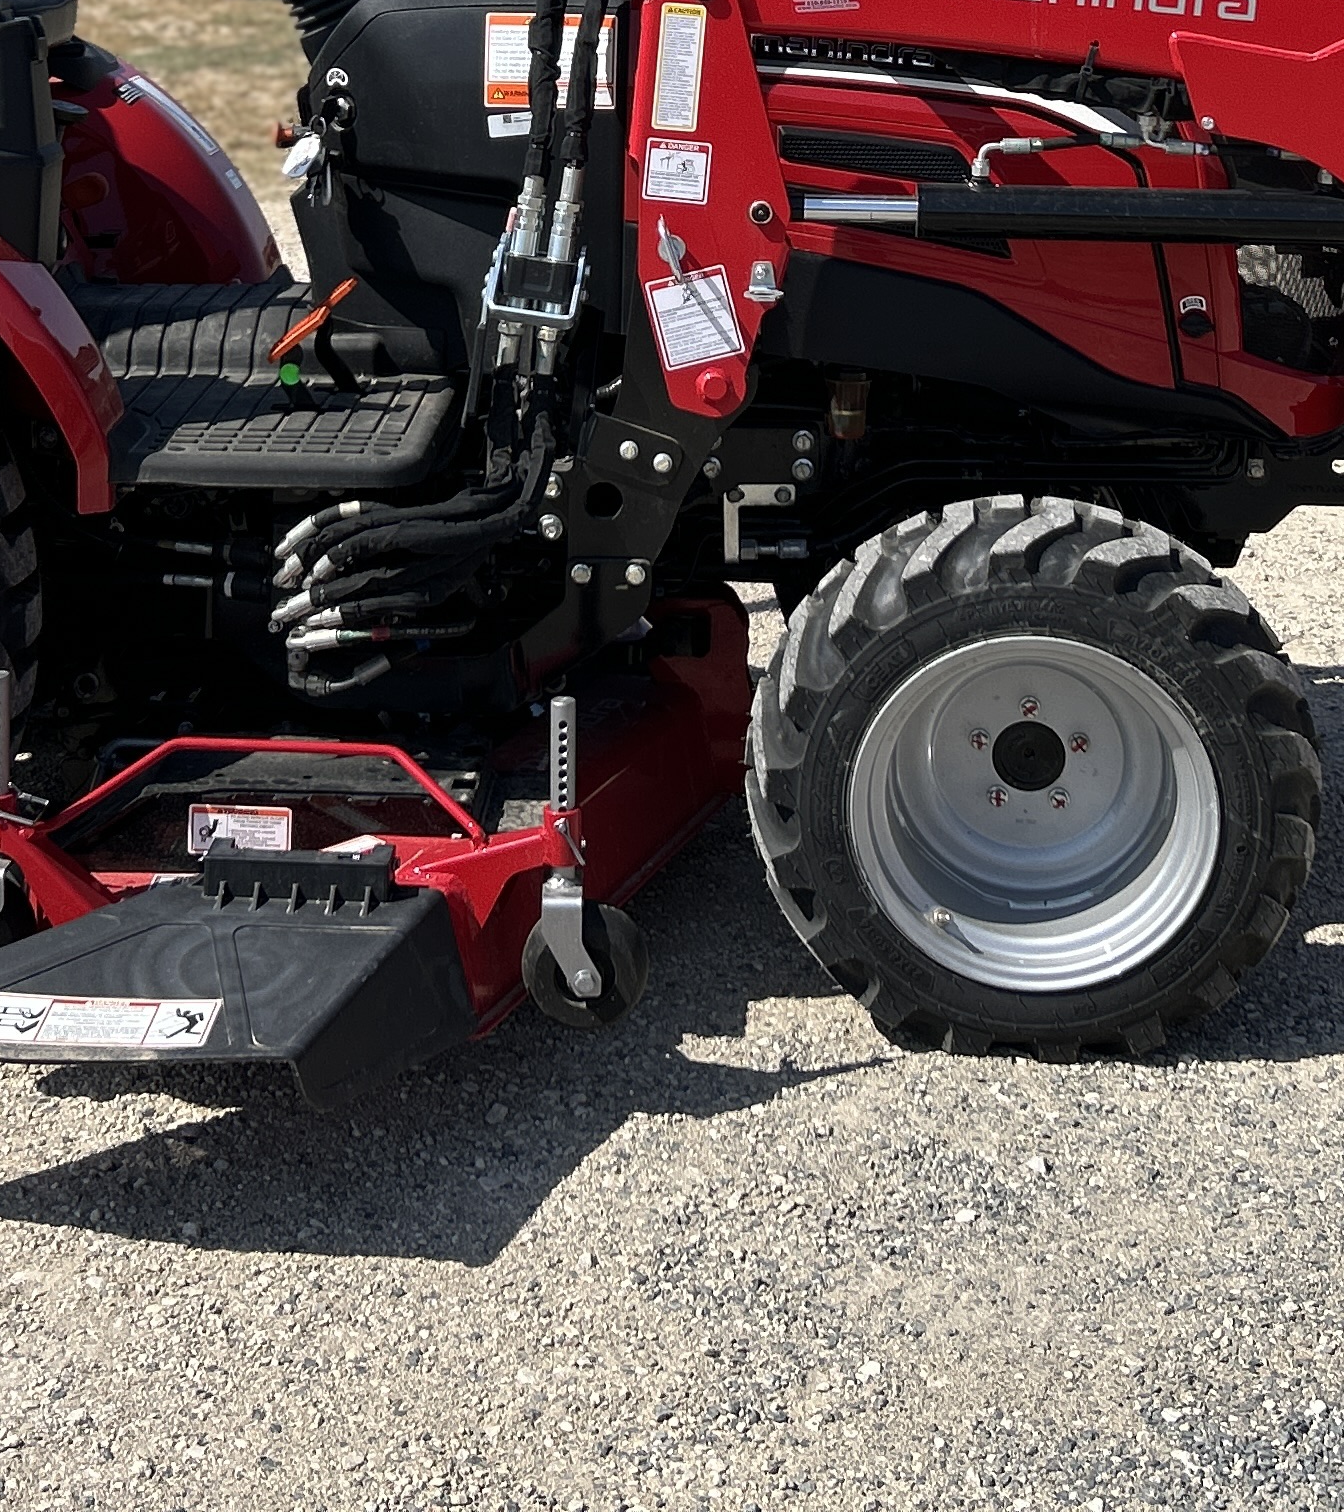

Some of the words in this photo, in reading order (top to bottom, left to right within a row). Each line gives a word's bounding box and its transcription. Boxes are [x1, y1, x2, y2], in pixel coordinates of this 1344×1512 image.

[750, 33, 936, 68] mahindra
[667, 142, 700, 152] DANGER
[863, 645, 907, 690] CEAT
